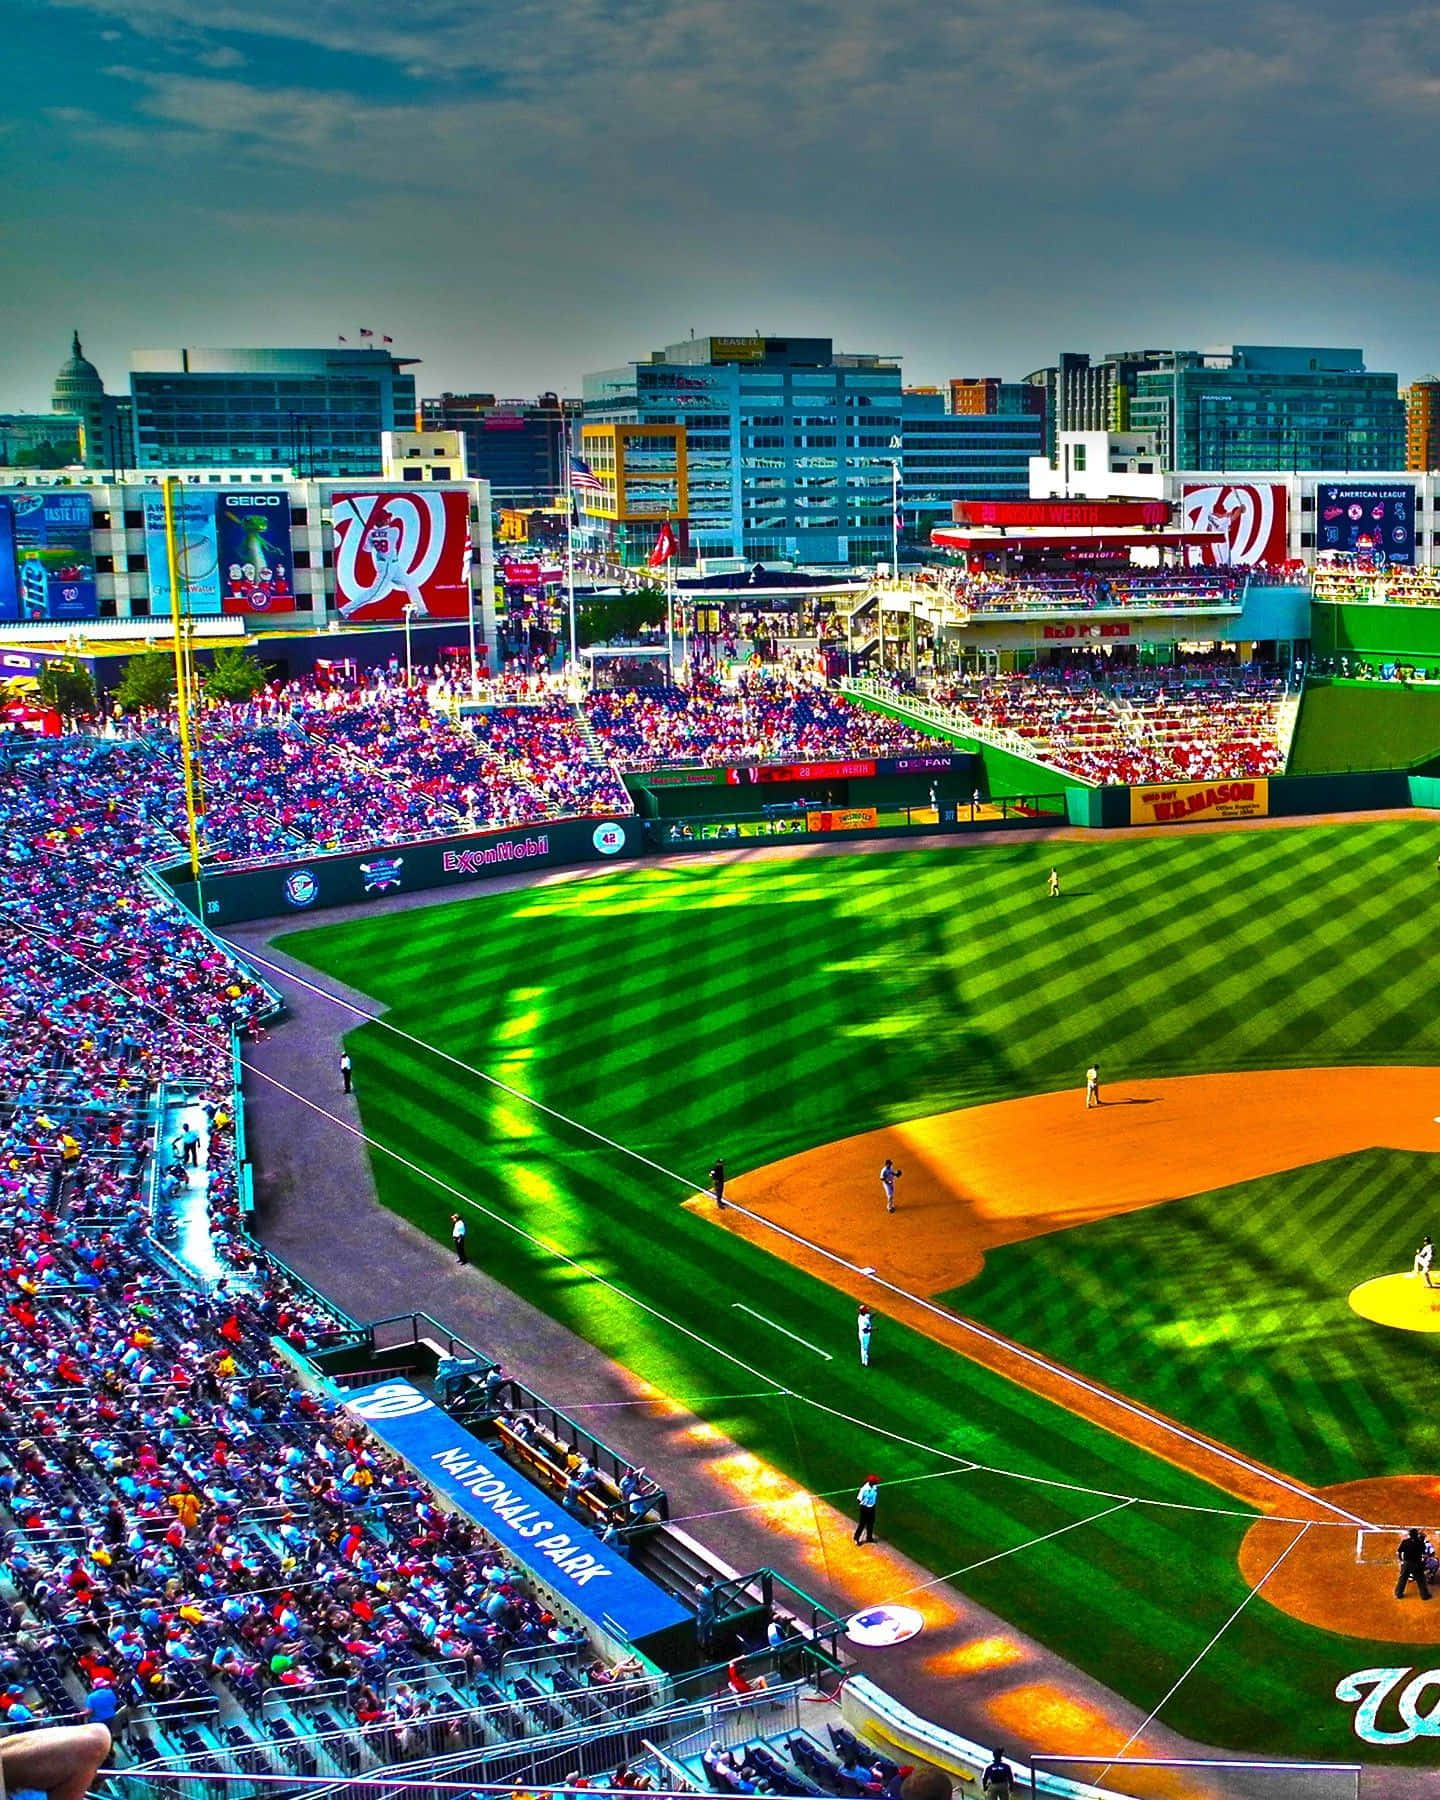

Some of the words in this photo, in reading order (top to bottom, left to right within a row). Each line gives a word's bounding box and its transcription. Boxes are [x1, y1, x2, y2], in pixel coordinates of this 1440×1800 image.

[226, 495, 281, 507] GEICO
[44, 508, 70, 520] TASTE
[1050, 506, 1098, 522] WERTH
[1043, 624, 1076, 639] RED
[602, 833, 617, 843] 42
[443, 834, 549, 874] ExxonMobil
[431, 1446, 553, 1538] NATIONALS
[533, 1534, 613, 1587] PARK
